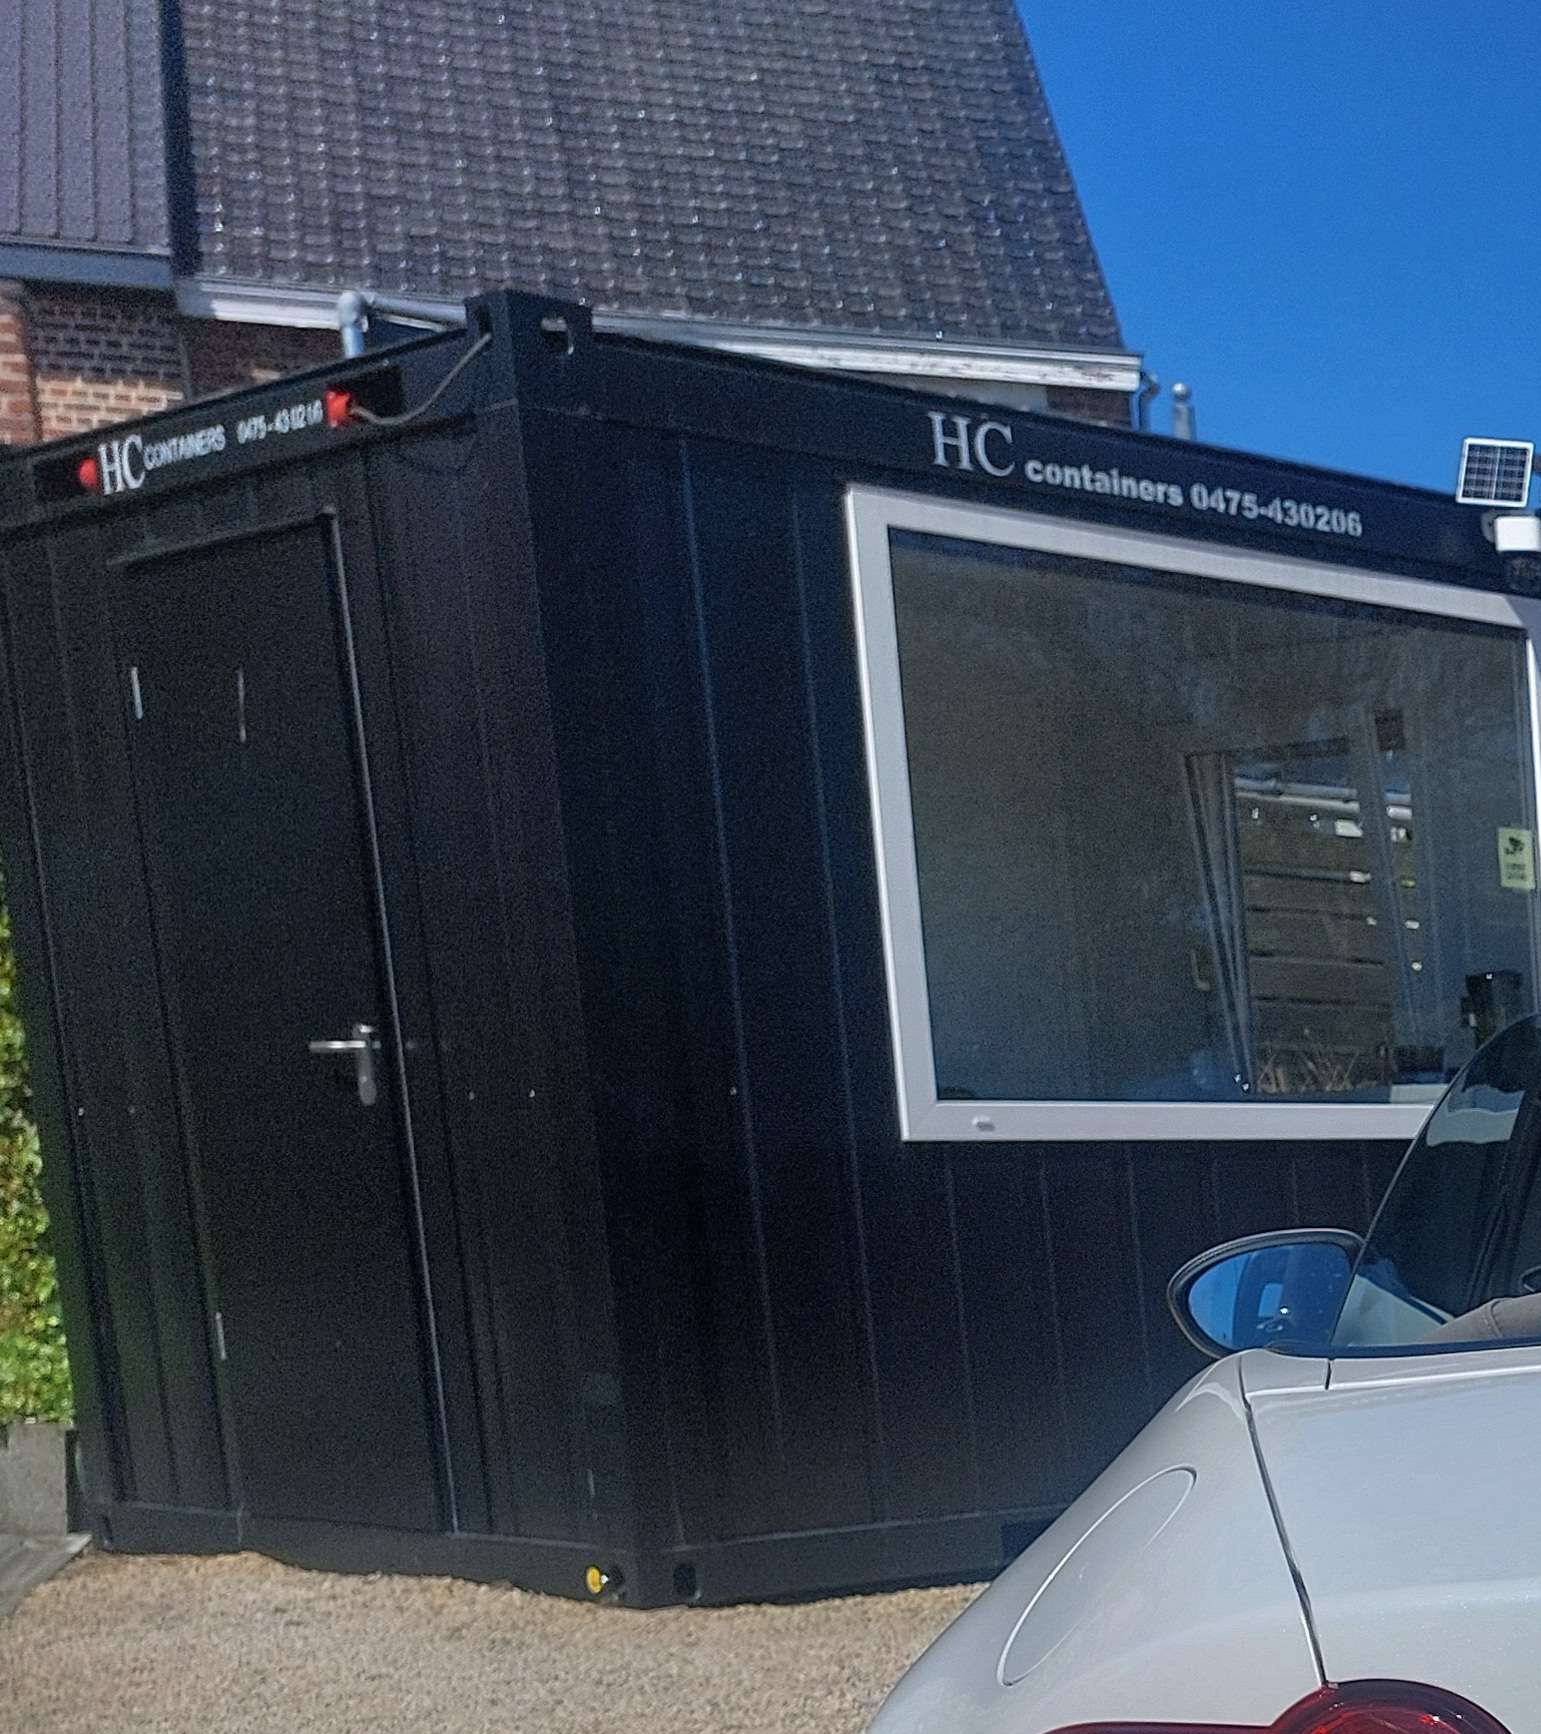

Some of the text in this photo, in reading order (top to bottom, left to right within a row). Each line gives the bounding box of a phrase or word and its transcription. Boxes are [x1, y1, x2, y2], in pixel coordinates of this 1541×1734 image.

[98, 434, 145, 496] HC
[143, 424, 226, 471] CONTAINERS
[928, 411, 1363, 538] HC containers 0475-430206
